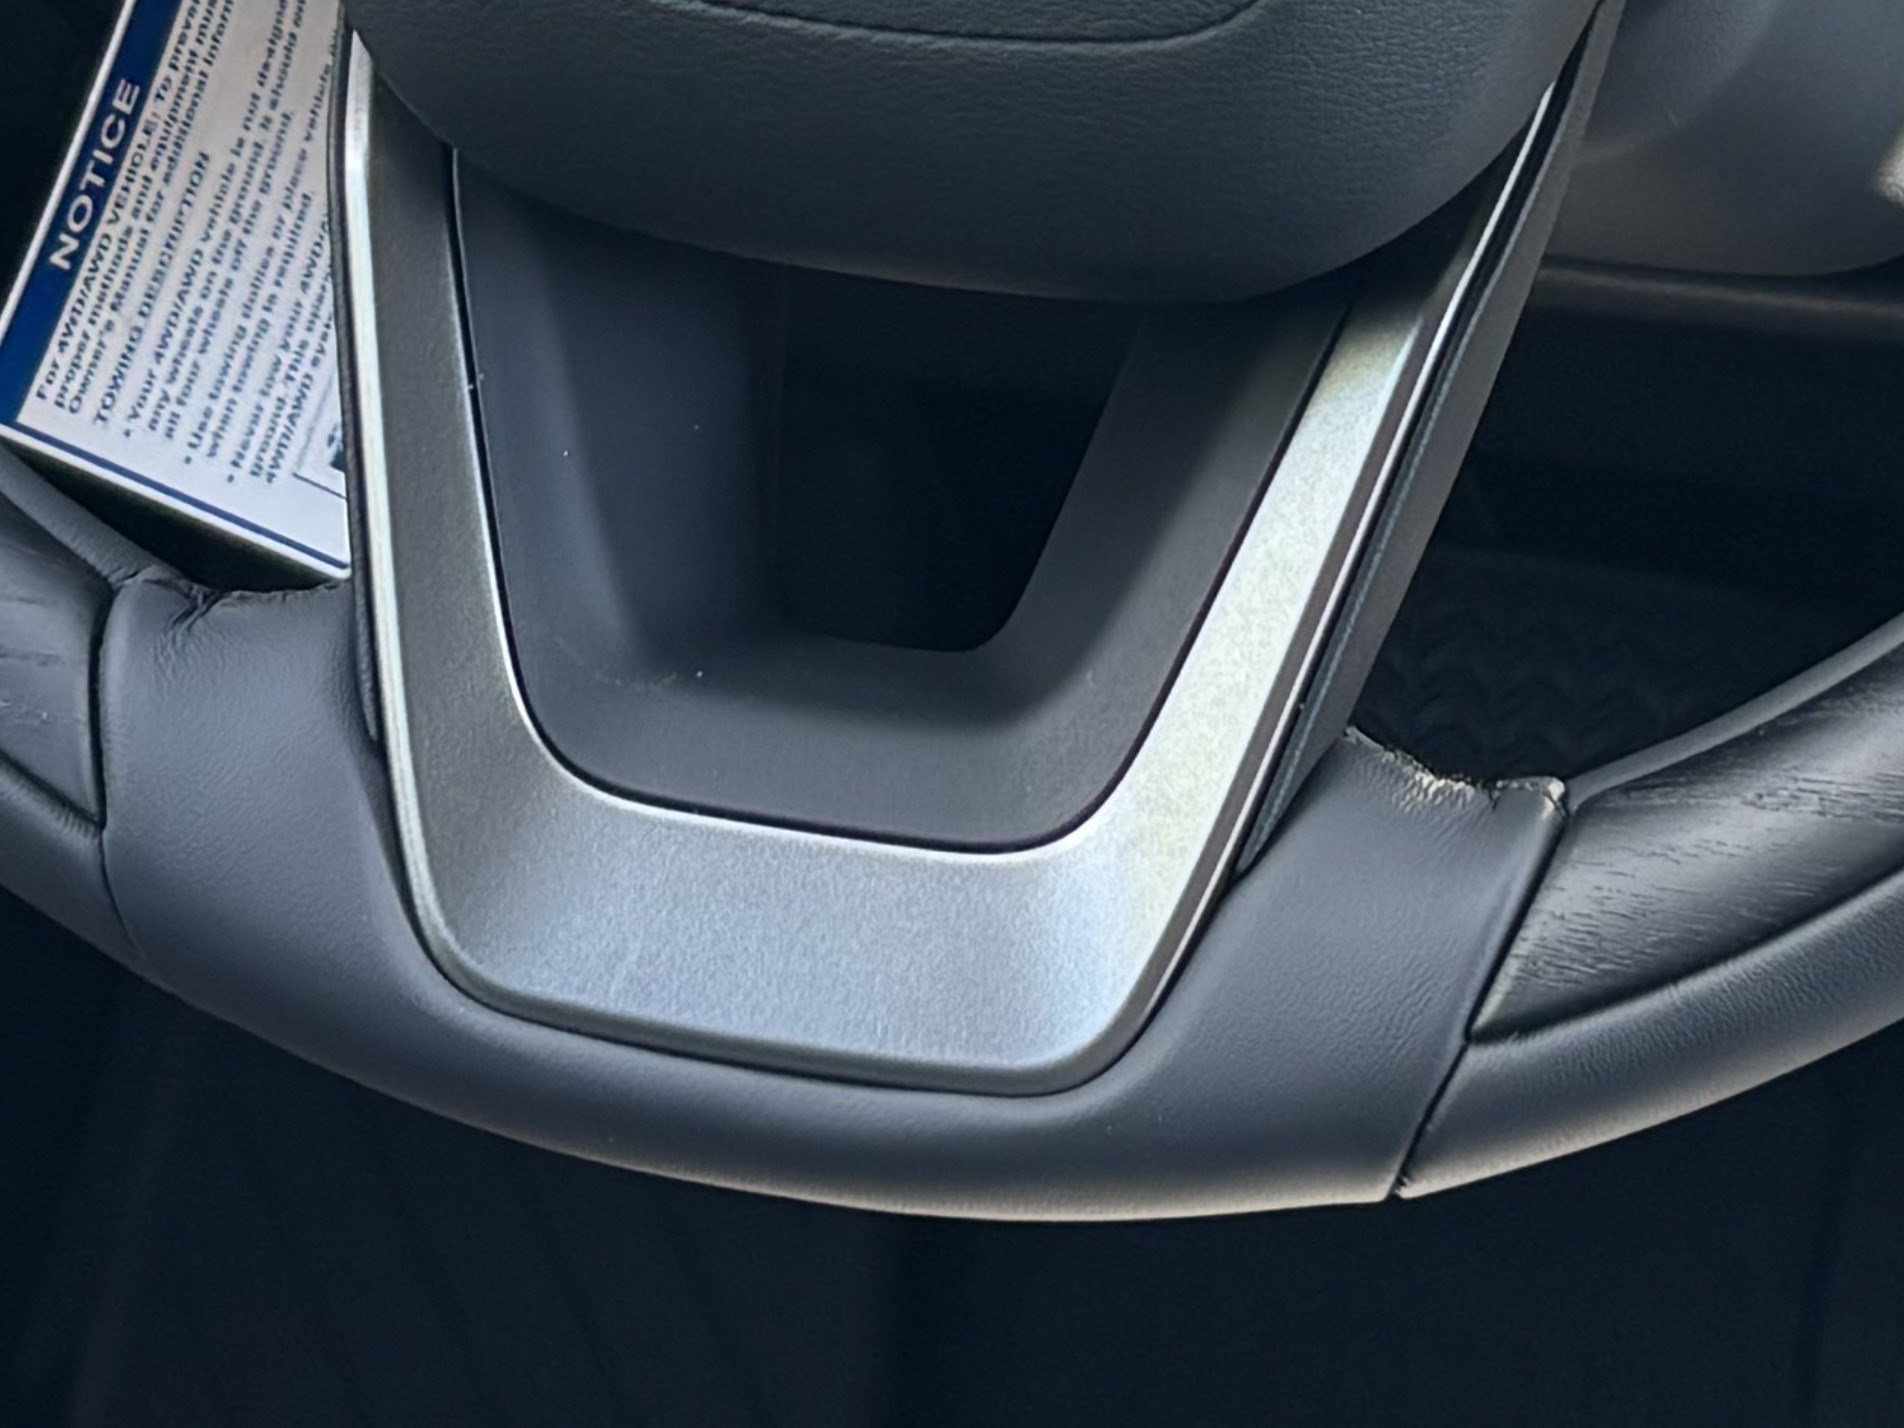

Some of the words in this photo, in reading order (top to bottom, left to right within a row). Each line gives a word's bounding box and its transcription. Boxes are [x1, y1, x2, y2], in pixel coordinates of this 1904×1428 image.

[48, 76, 143, 271] NOTICE
[54, 231, 113, 354] 4WD/AWD
[92, 323, 144, 426] TOWING
[136, 149, 211, 319] DESCRIPTION
